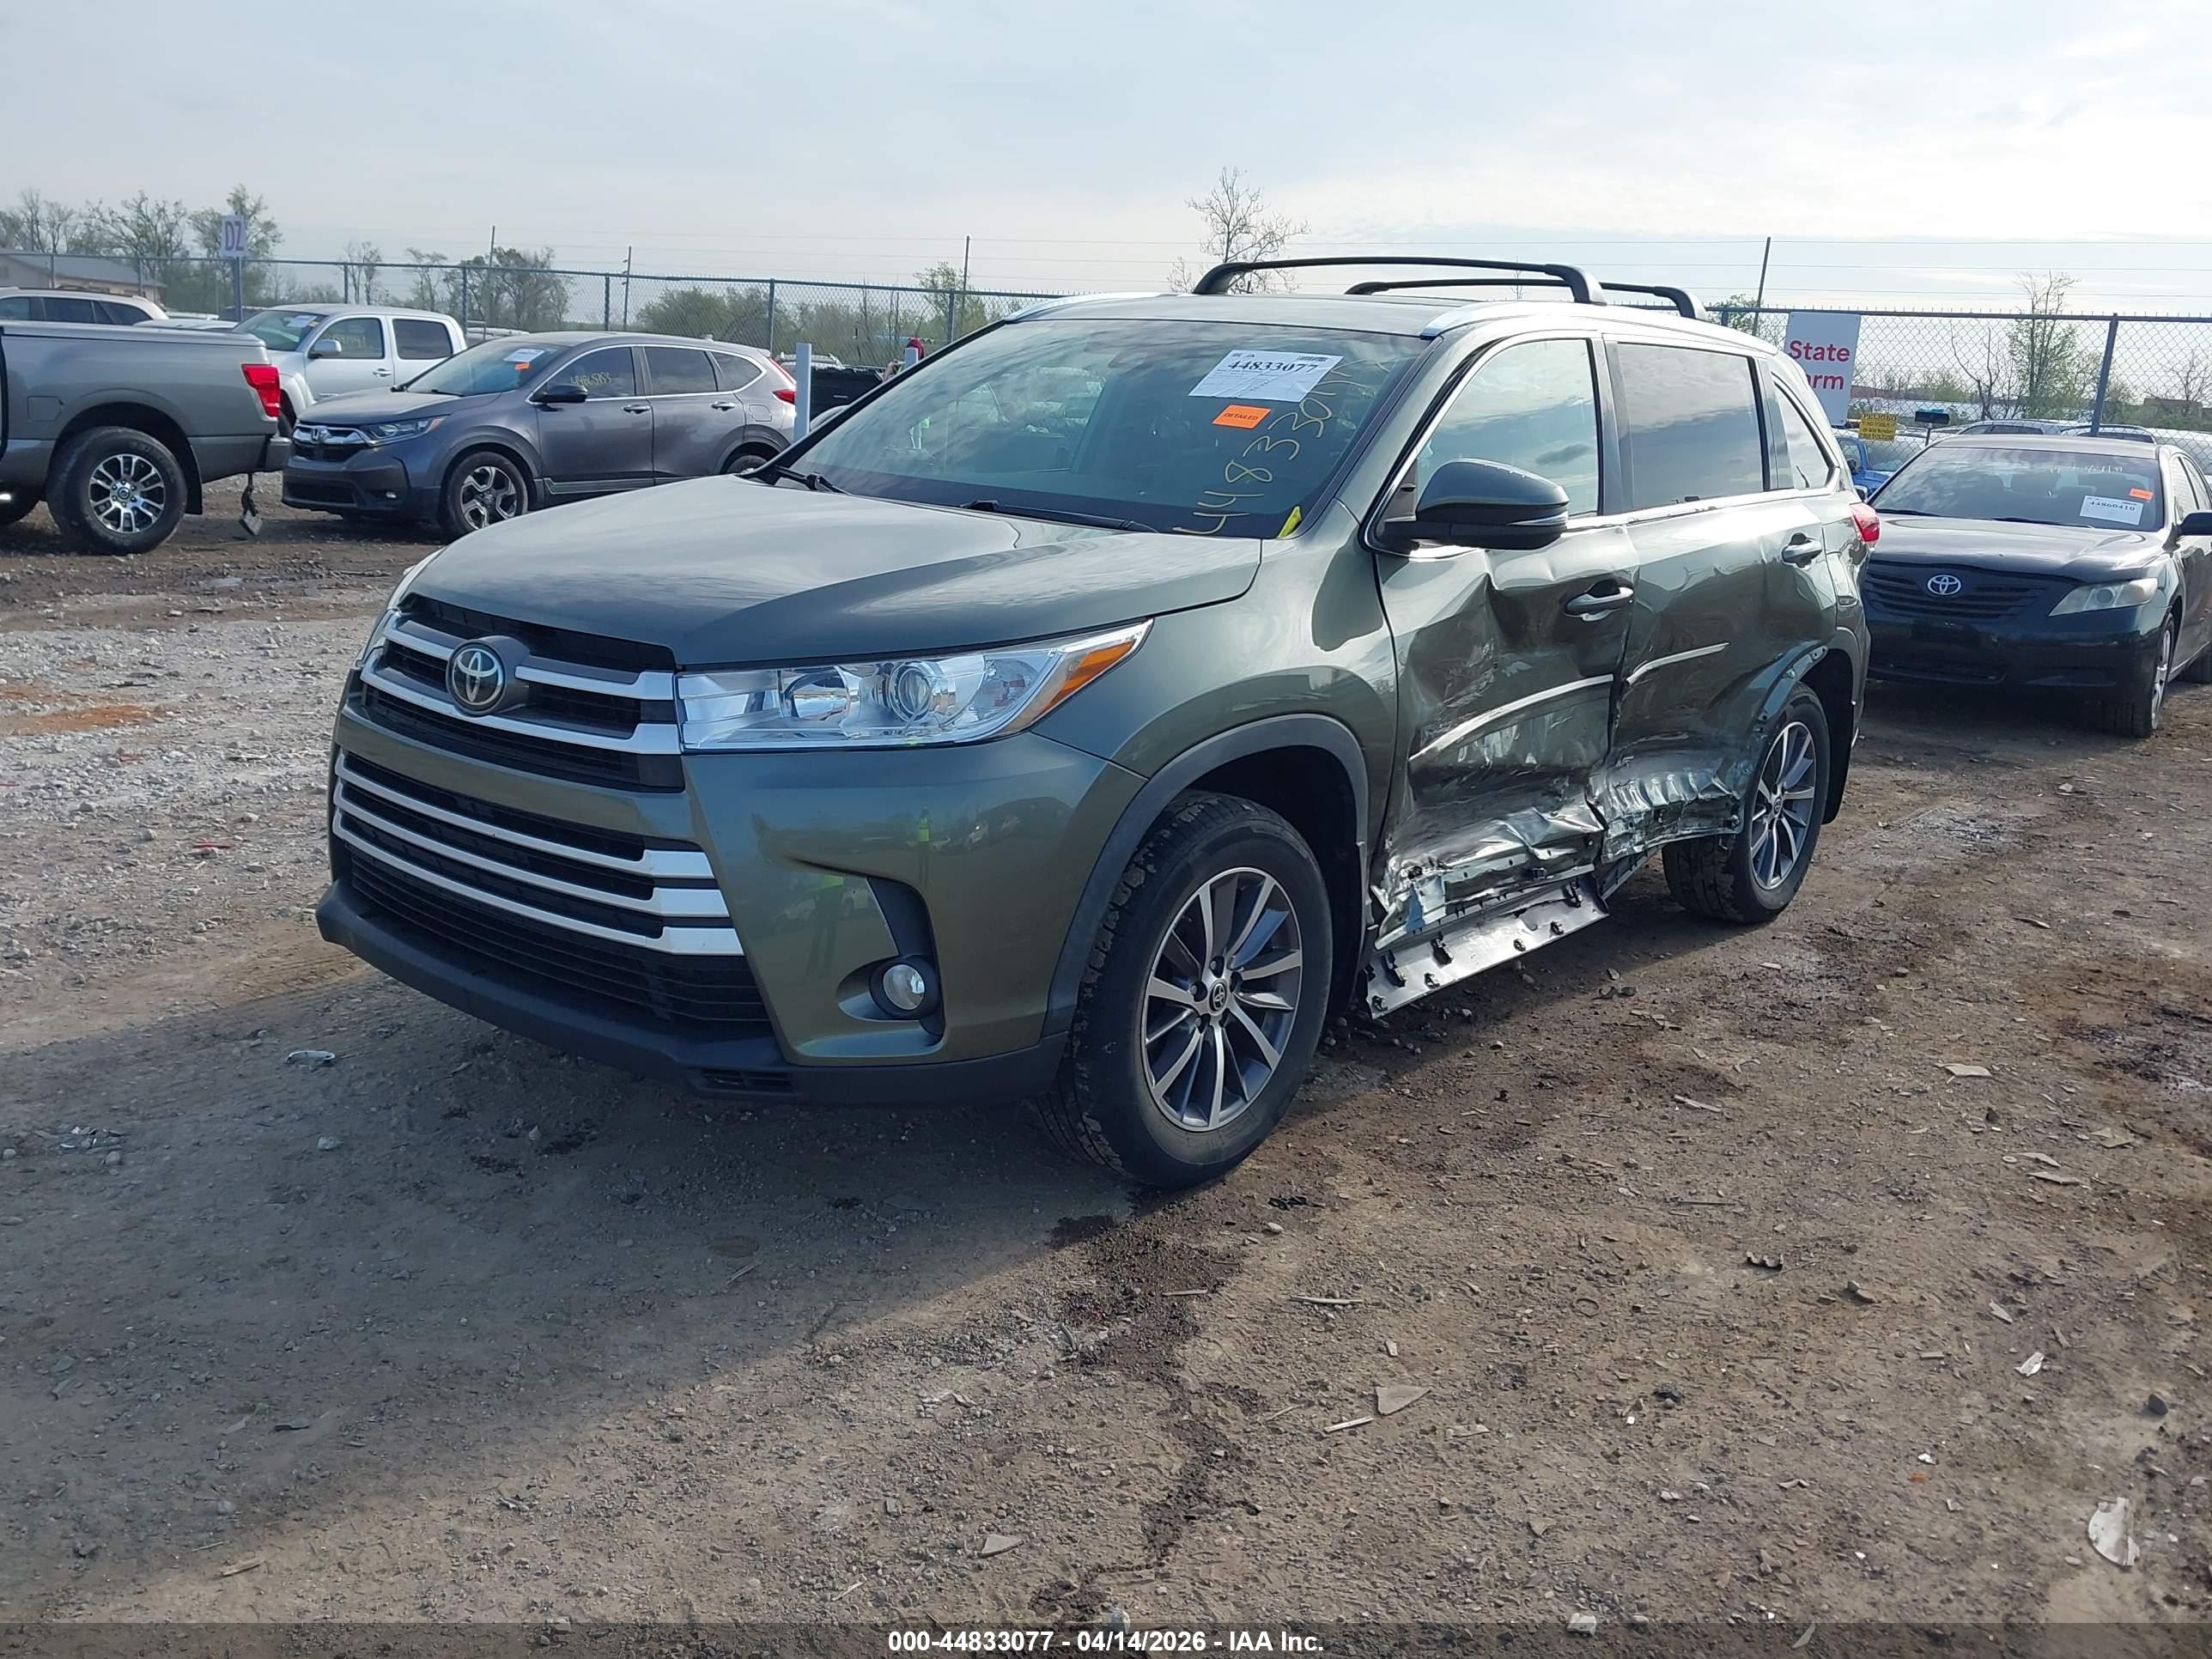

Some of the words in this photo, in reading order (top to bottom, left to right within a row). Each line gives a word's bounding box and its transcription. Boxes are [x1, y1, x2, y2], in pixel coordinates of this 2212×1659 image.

[1789, 340, 1850, 362] State
[1228, 361, 1318, 373] 44833077
[1806, 374, 1844, 390] rm
[1224, 412, 1259, 421] DETAILED
